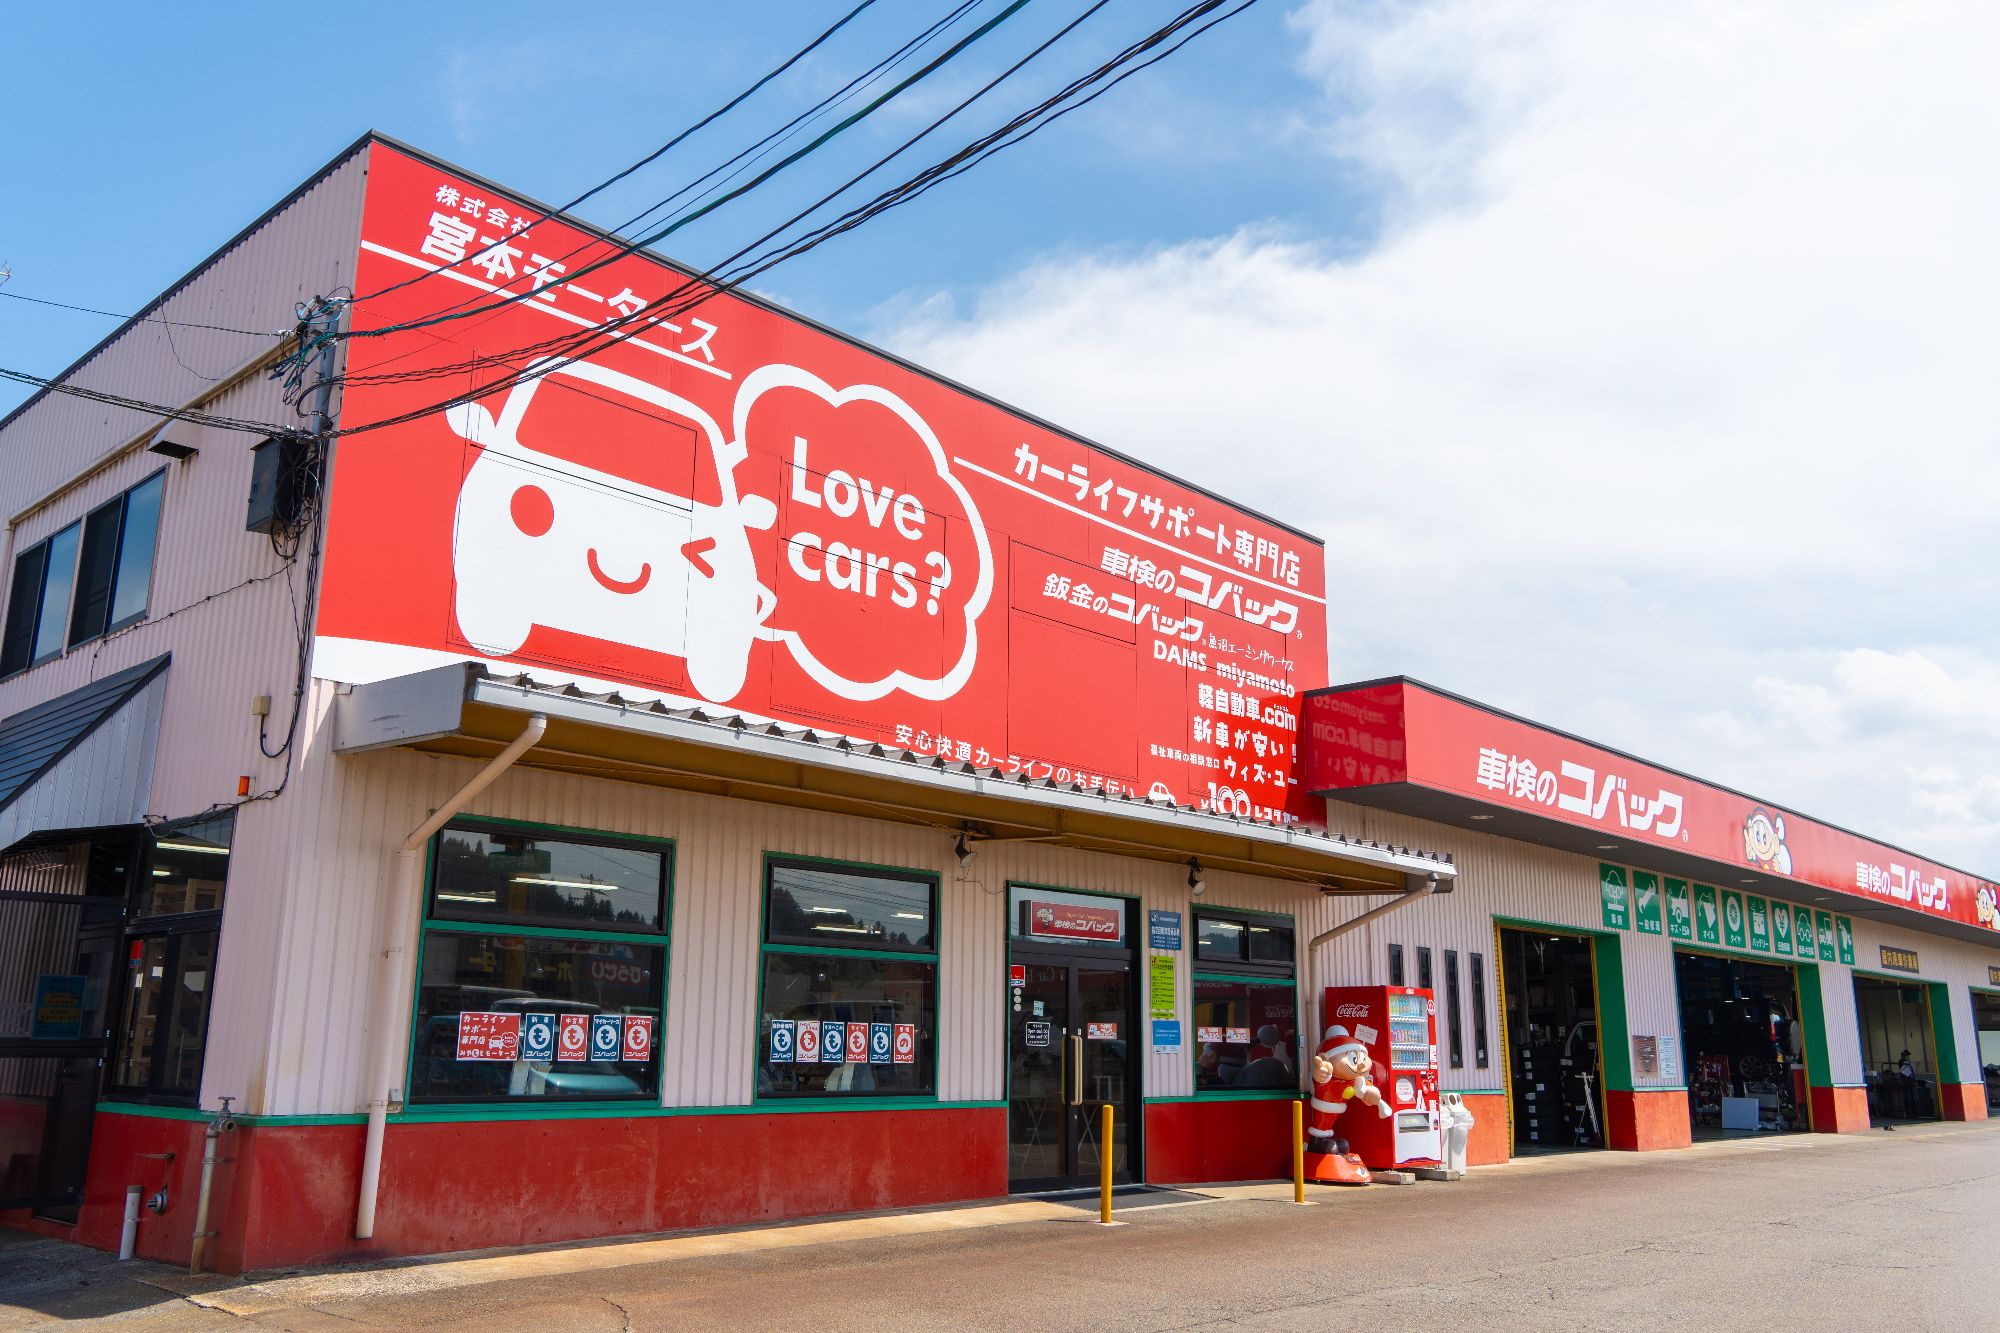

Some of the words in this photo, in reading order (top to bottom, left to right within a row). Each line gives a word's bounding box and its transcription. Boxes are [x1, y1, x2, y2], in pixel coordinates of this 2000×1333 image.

[436, 184, 535, 239] 株式会社
[420, 211, 719, 363] 宮本モータース
[792, 435, 926, 541] Love
[1014, 442, 1300, 587] カーライフサポート専門店
[787, 531, 952, 616] cars?
[1100, 545, 1299, 634] 車検のコバック
[1042, 572, 1204, 642] 鈑金のコバック
[1153, 640, 1207, 672] DAMS
[1216, 661, 1295, 698] miyamoto
[1198, 683, 1297, 732] 軽自動車.com
[1150, 743, 1220, 770] 福祉車両の相談窓口
[1476, 747, 1684, 838] 車検のコバック
[1855, 861, 1947, 911] 車検のコバック
[1730, 935, 1741, 944] タイヤ
[463, 1014, 507, 1024] カーライフ
[1336, 1004, 1370, 1018] Coca-Cola
[462, 1025, 497, 1034] サポート
[565, 1017, 584, 1025] 中古車
[461, 1035, 486, 1045] 専門店
[532, 1027, 546, 1046] も
[567, 1028, 580, 1046] も
[600, 1028, 612, 1045] も
[632, 1028, 644, 1046] も
[778, 1032, 788, 1047] も
[804, 1032, 813, 1049] も
[829, 1034, 839, 1049] も
[852, 1034, 863, 1050] も
[877, 1035, 886, 1050] も
[900, 1038, 909, 1048] の
